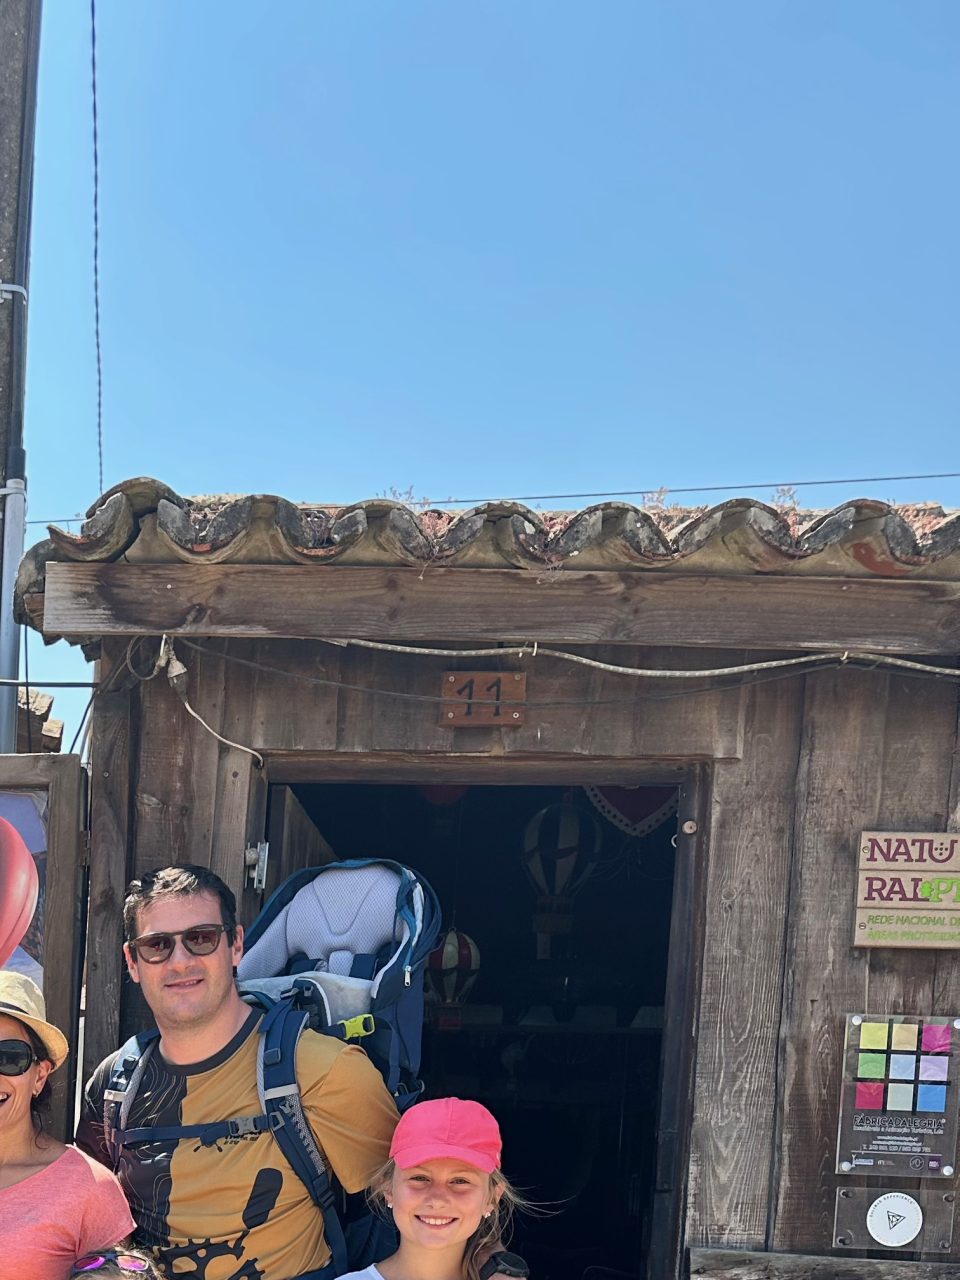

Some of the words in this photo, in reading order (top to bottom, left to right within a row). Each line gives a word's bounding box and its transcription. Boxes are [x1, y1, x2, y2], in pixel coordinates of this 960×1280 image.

[456, 677, 502, 717] 11
[866, 838, 959, 864] NATU
[866, 914, 894, 925] REDE
[895, 915, 947, 927] NACIONAL
[949, 916, 960, 927] D
